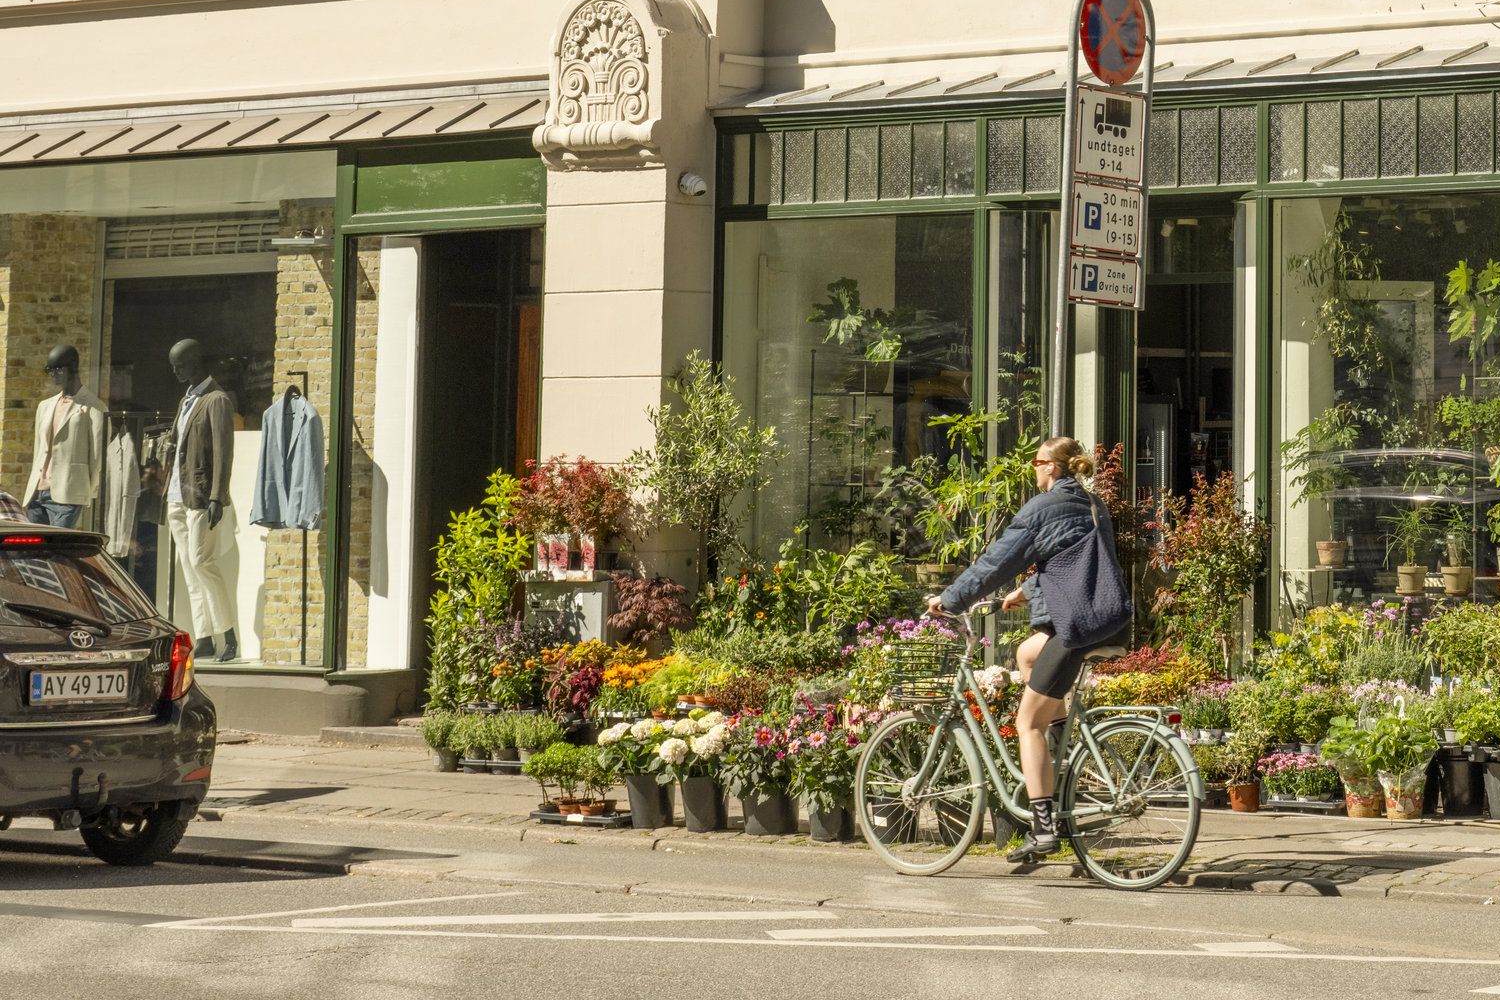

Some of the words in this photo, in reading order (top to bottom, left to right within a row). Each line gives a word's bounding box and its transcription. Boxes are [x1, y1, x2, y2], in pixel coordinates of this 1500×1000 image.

[1088, 140, 1135, 157] undtaget
[1100, 158, 1122, 173] 9-14
[1103, 192, 1117, 206] 30
[1120, 196, 1138, 209] min
[1088, 205, 1099, 226] P
[1106, 211, 1134, 227] 14-18
[1106, 229, 1137, 247] (9-15)
[1084, 266, 1095, 289] P
[1107, 268, 1126, 280] Zone
[1099, 281, 1119, 294] Øvrig
[1122, 284, 1133, 294] tid
[44, 675, 67, 696] AY
[71, 675, 91, 695] 49
[96, 674, 125, 694] 170
